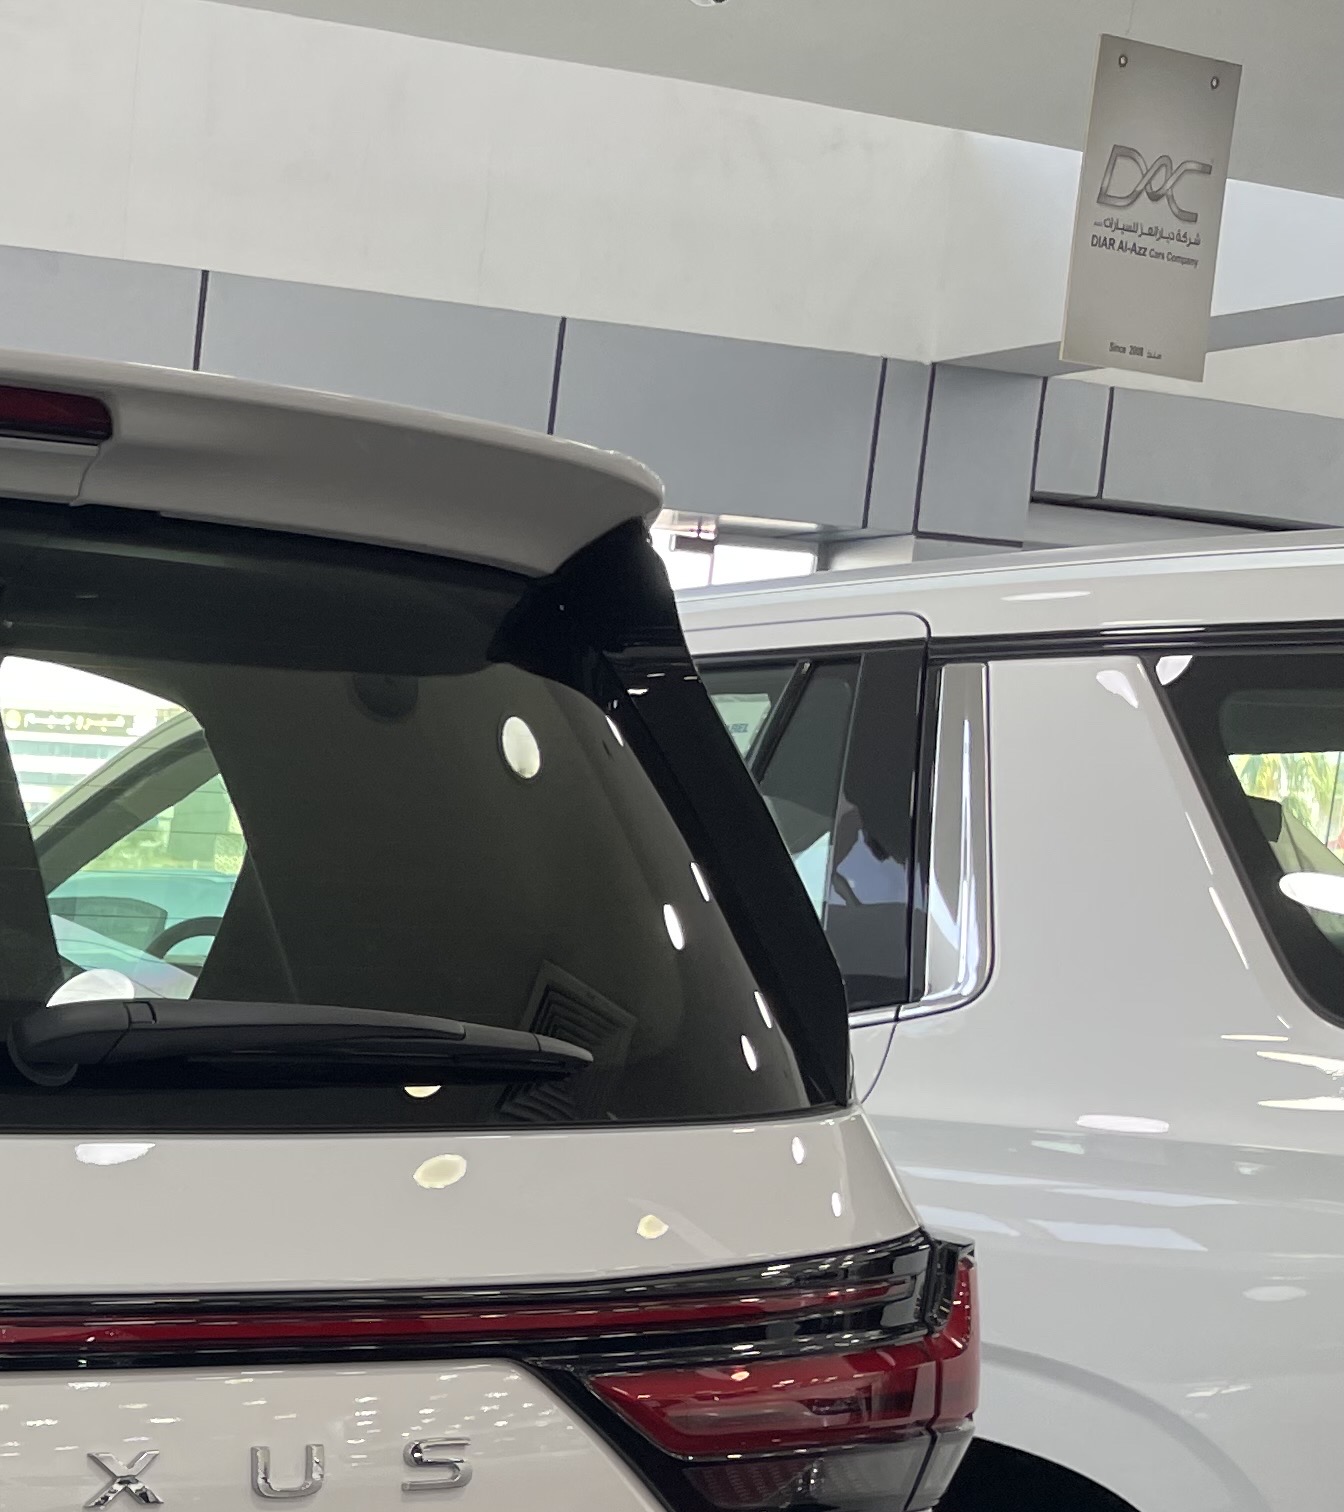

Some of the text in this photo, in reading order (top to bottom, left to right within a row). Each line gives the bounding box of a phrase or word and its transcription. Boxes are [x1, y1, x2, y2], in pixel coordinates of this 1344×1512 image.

[1103, 217, 1139, 235] للسيارات
[1175, 229, 1201, 248] شركة
[1091, 234, 1116, 251] DIAR
[1166, 251, 1200, 269] Company
